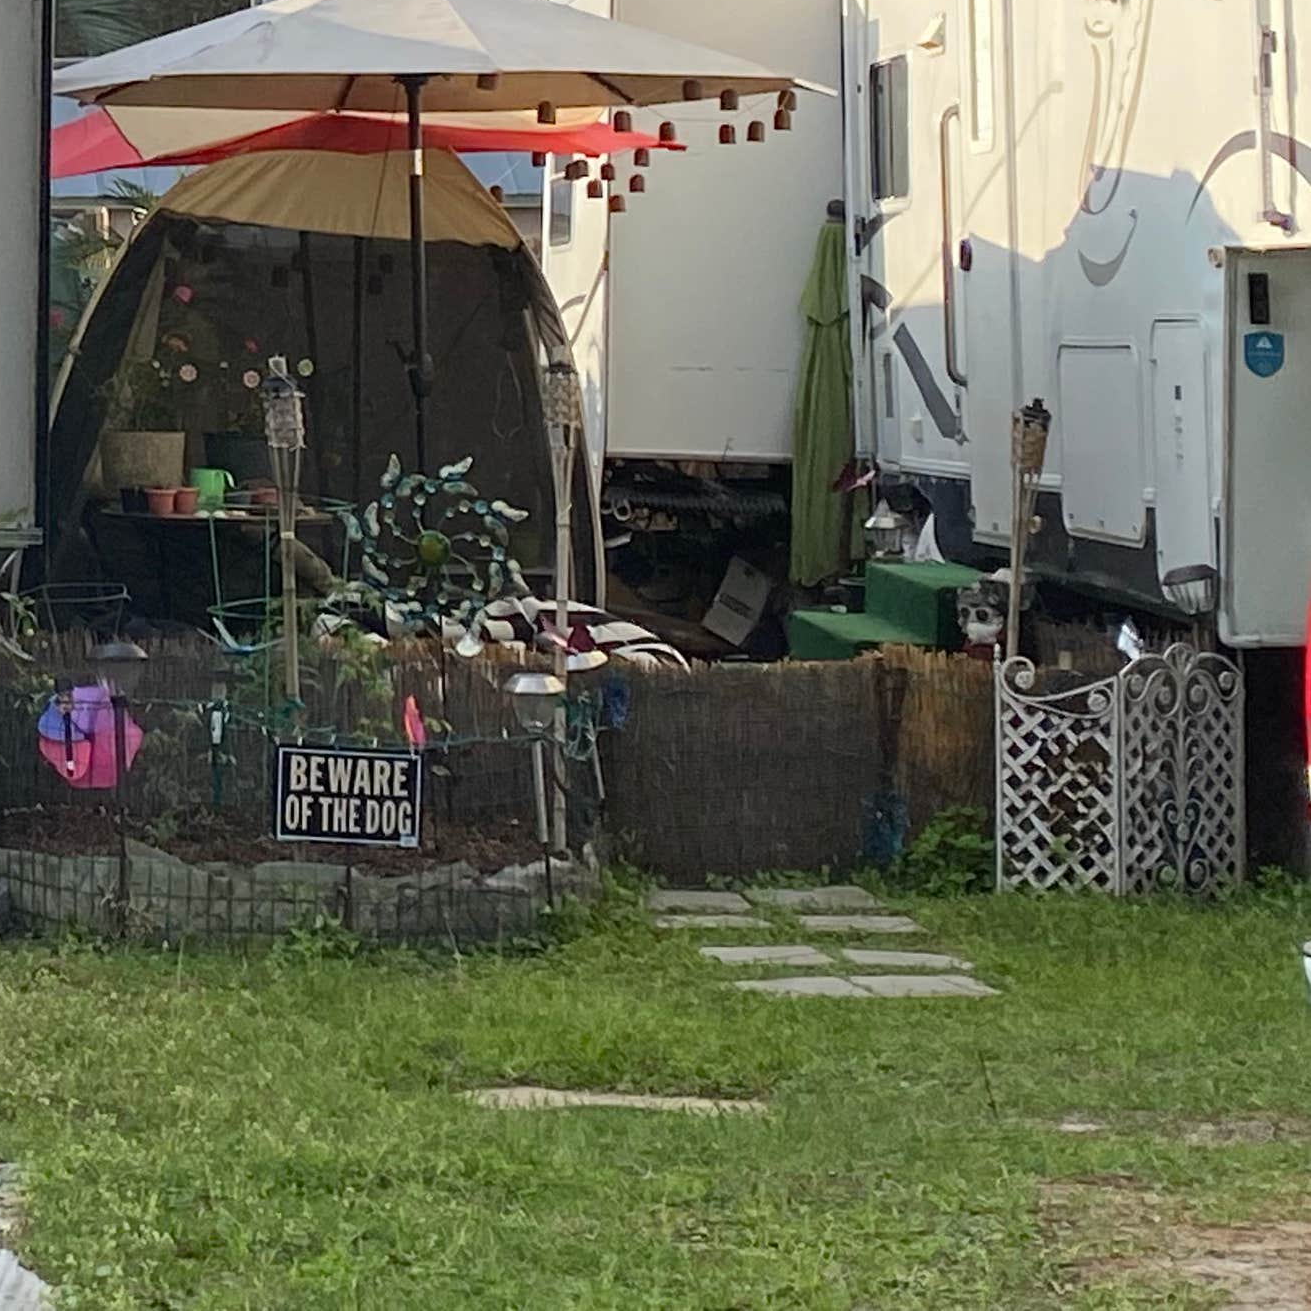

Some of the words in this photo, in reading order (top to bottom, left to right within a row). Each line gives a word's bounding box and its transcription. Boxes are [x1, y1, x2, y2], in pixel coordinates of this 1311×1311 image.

[289, 754, 409, 797] BEWARE
[285, 794, 314, 831] OF
[318, 795, 362, 834] THE
[365, 798, 412, 837] DOG
